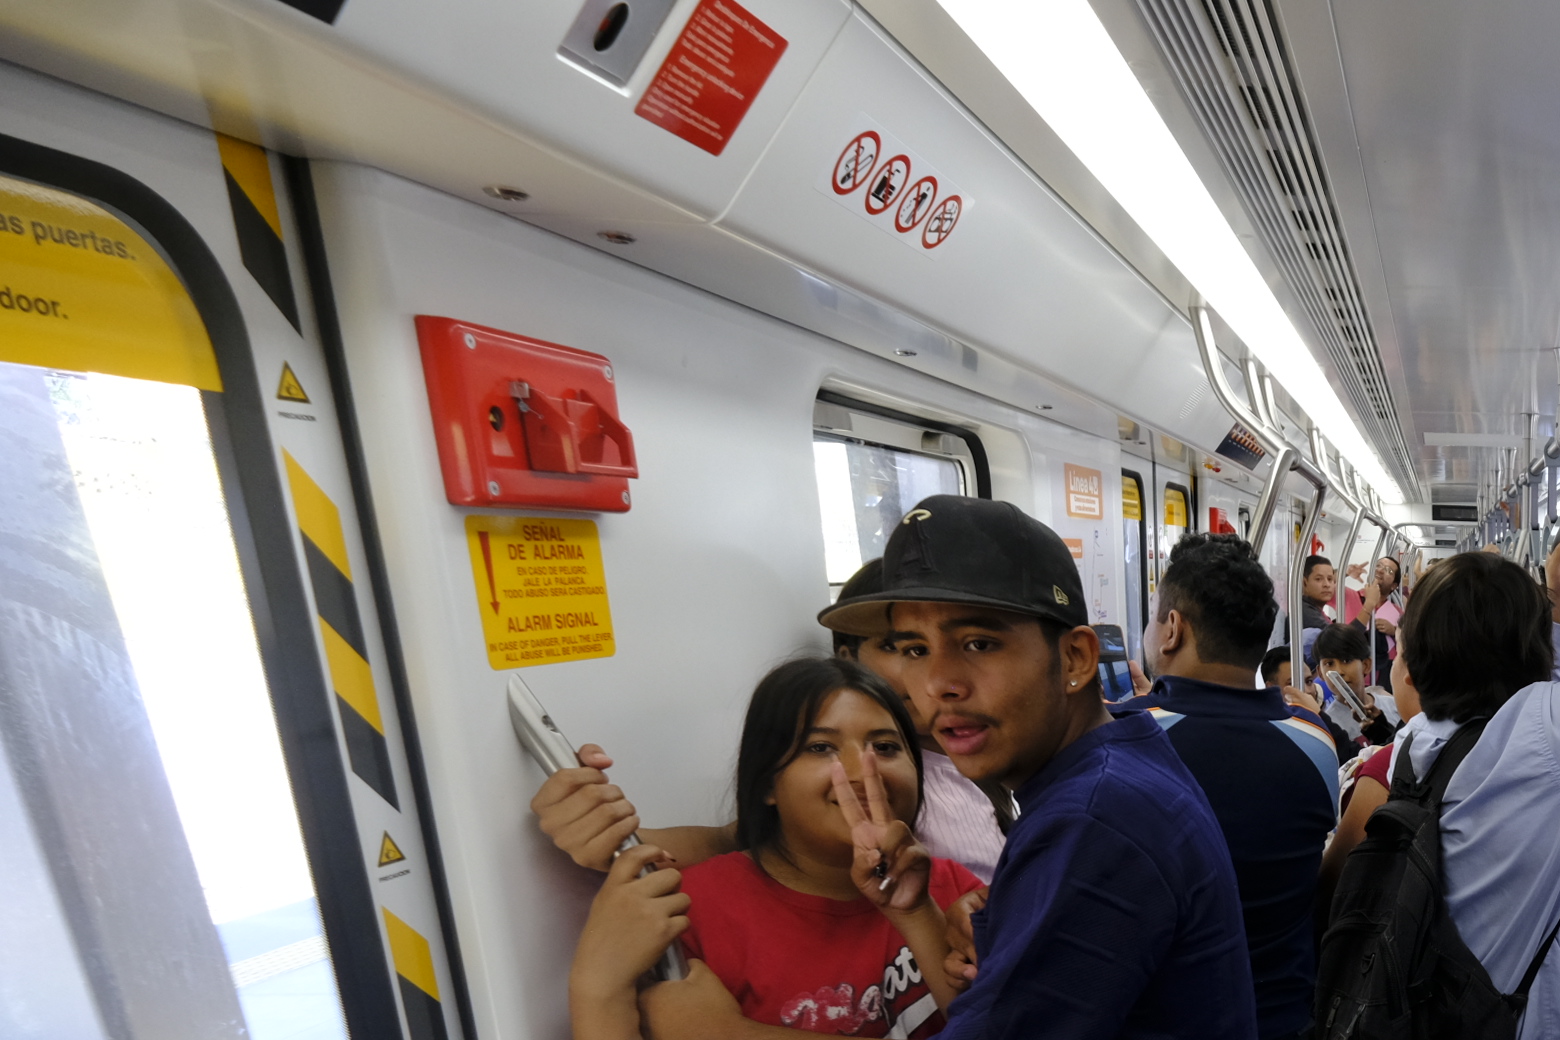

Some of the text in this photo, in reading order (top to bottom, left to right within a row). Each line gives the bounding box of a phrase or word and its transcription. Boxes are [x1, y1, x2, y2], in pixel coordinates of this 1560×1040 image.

[30, 220, 137, 261] puertas.
[0, 285, 70, 320] door.
[522, 521, 566, 542] SEÑAL
[507, 543, 586, 561] DE ALARMA
[516, 566, 527, 576] EN
[528, 566, 547, 576] CASO
[548, 565, 558, 576] DE
[523, 577, 541, 587] JALE
[542, 577, 553, 587] LA
[503, 589, 524, 599] TODO
[525, 588, 549, 599] ABUSO
[507, 611, 599, 634] ALARM SIGNAL
[498, 641, 519, 652] CASE
[519, 640, 530, 650] OF
[561, 635, 578, 646] PULL
[578, 634, 592, 644] THE
[505, 652, 520, 662] ALL
[520, 649, 544, 661] ABUSE
[545, 648, 561, 658] WILL
